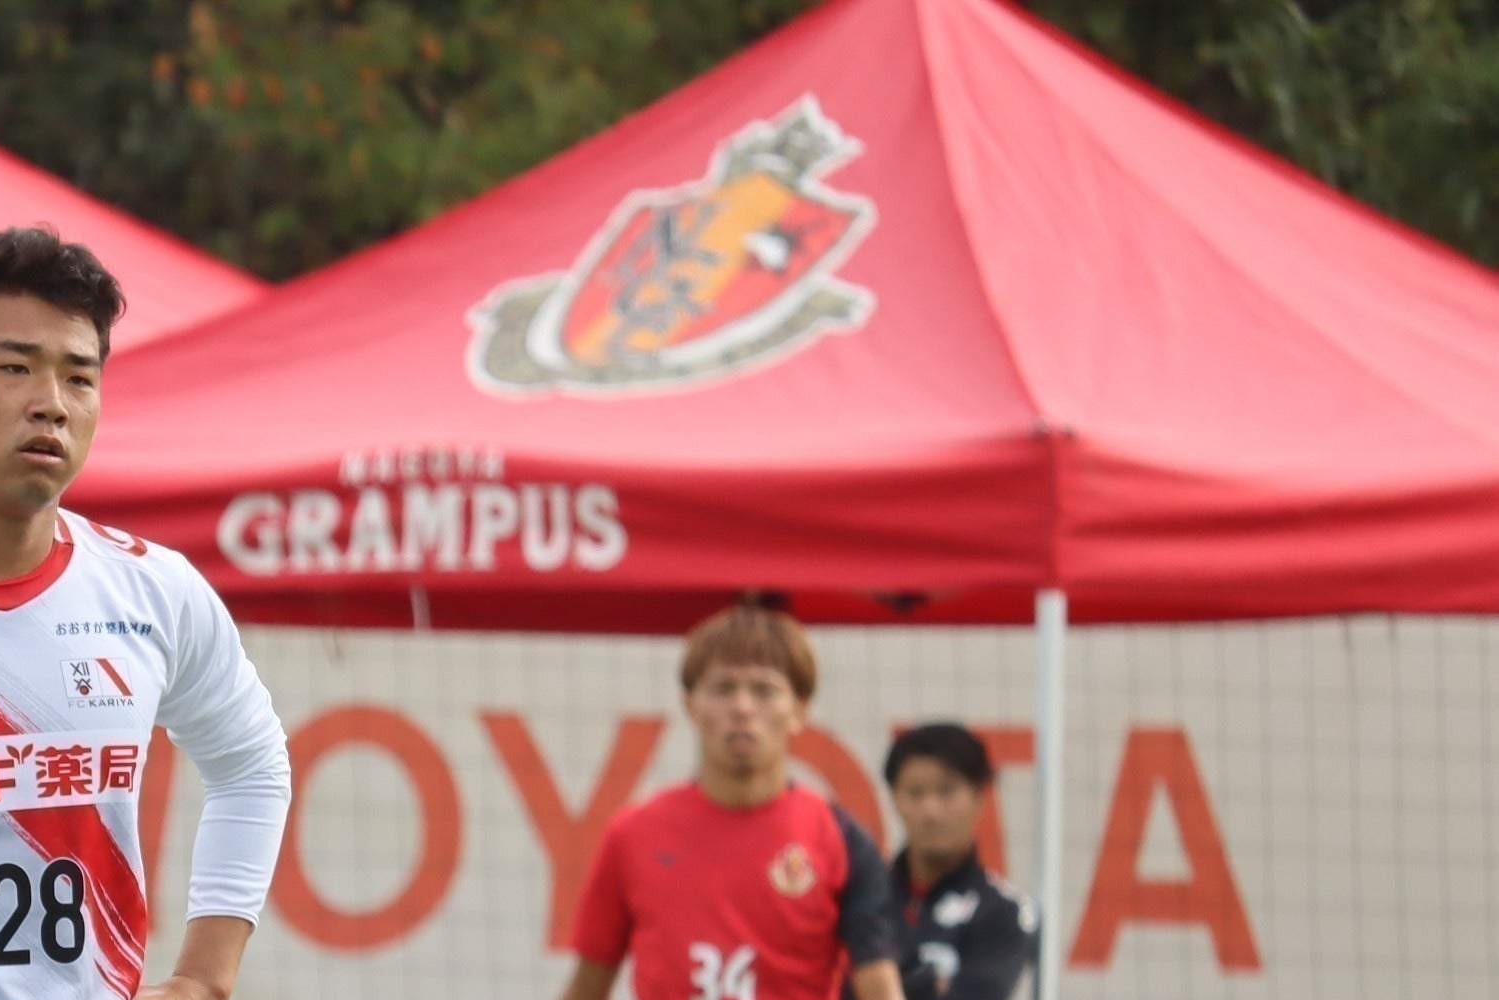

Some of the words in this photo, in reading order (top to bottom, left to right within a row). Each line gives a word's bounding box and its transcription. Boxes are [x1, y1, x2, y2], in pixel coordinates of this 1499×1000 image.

[215, 481, 630, 577] GRAMPUS
[88, 698, 135, 709] KARIYA
[137, 703, 1265, 976] OYTA
